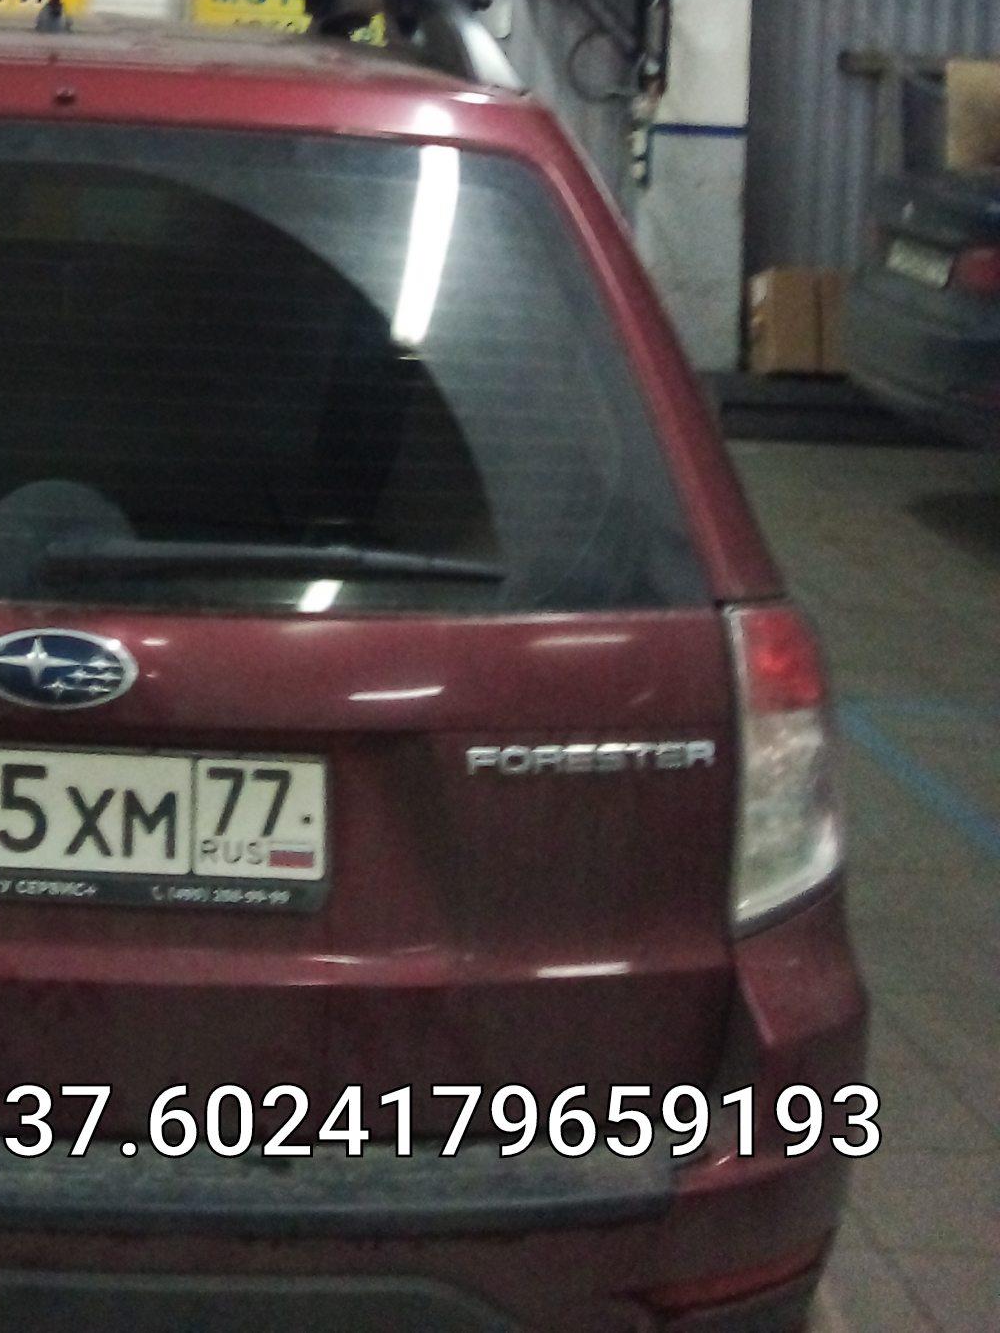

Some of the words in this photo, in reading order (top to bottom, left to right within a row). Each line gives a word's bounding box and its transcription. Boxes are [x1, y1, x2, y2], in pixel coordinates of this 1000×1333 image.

[464, 739, 716, 776] FORESTER
[205, 767, 293, 838] 77
[200, 838, 266, 866] RUS
